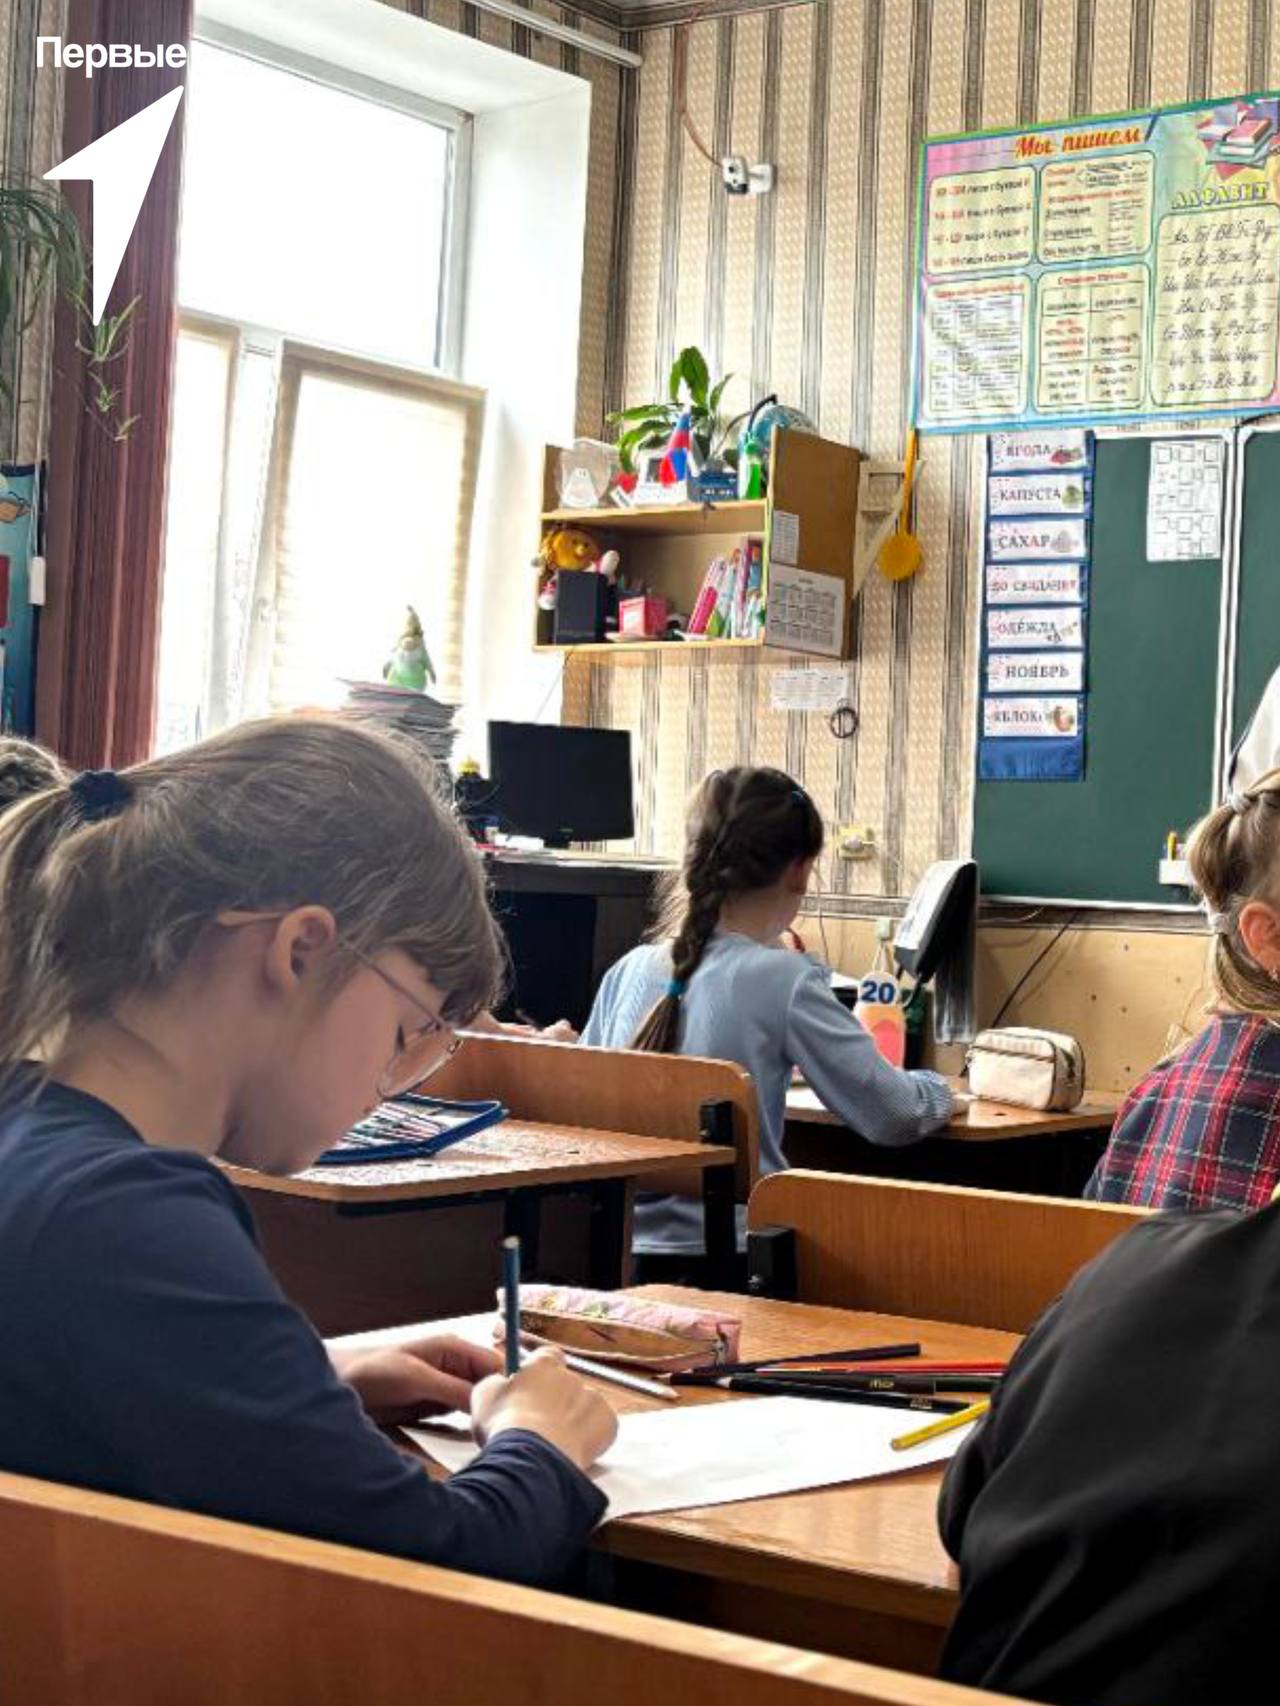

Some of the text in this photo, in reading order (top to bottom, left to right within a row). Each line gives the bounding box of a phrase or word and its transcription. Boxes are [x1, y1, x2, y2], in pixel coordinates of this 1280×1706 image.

[1015, 127, 1141, 158] Мы пишем
[1000, 487, 1062, 501] КАПУСТА
[861, 980, 895, 1005] 20
